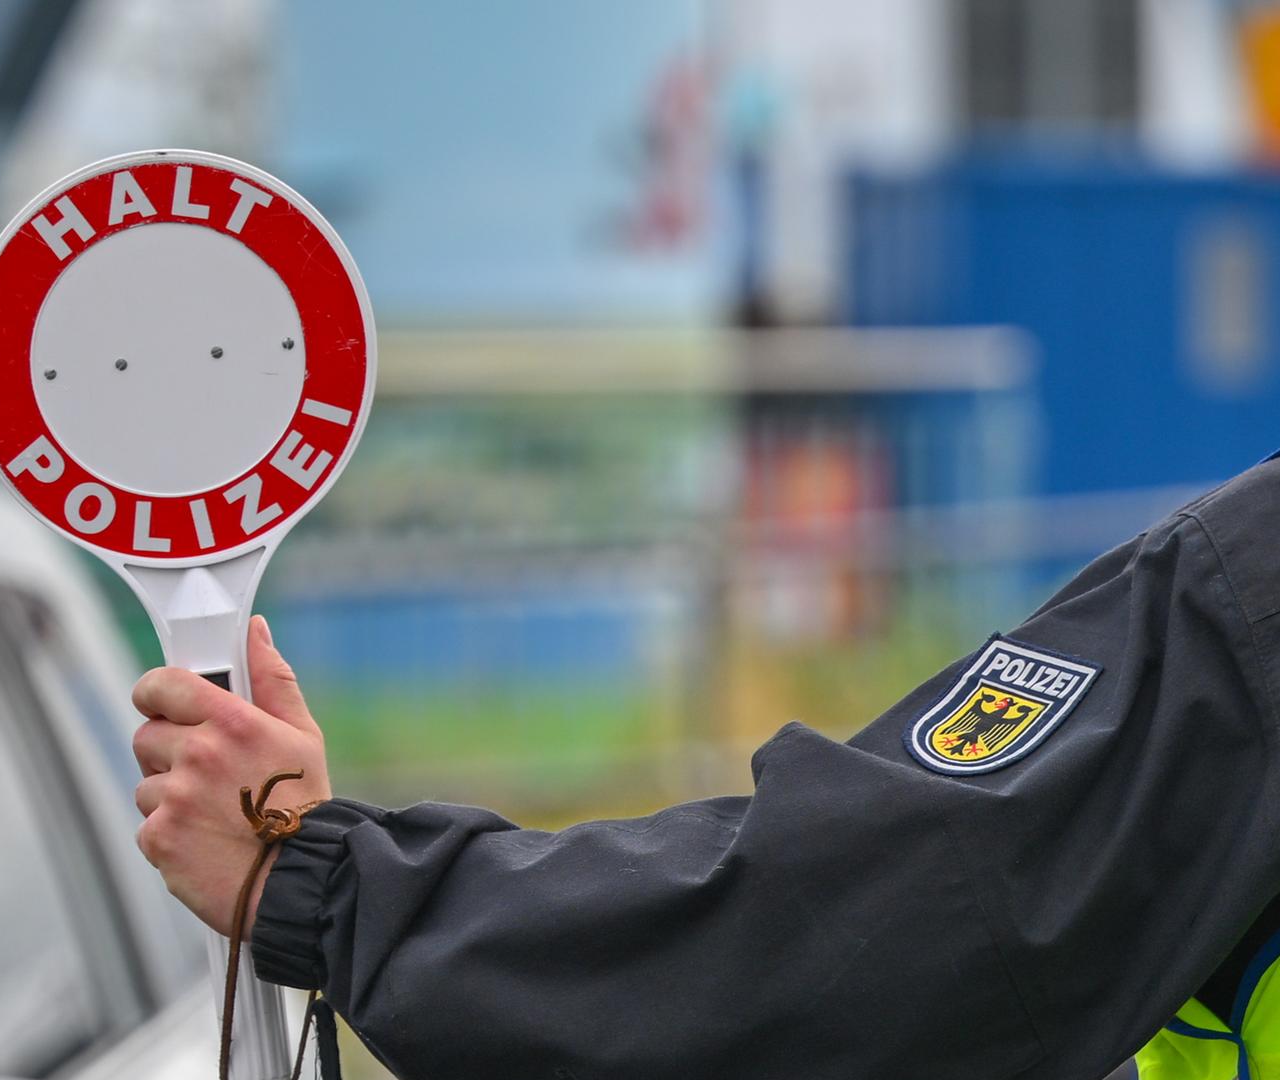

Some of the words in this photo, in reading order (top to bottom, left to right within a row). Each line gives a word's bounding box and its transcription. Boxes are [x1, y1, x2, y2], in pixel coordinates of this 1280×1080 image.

[30, 166, 274, 261] HALT
[6, 398, 353, 553] POLIZEI
[981, 652, 1081, 698] POLIZEI
